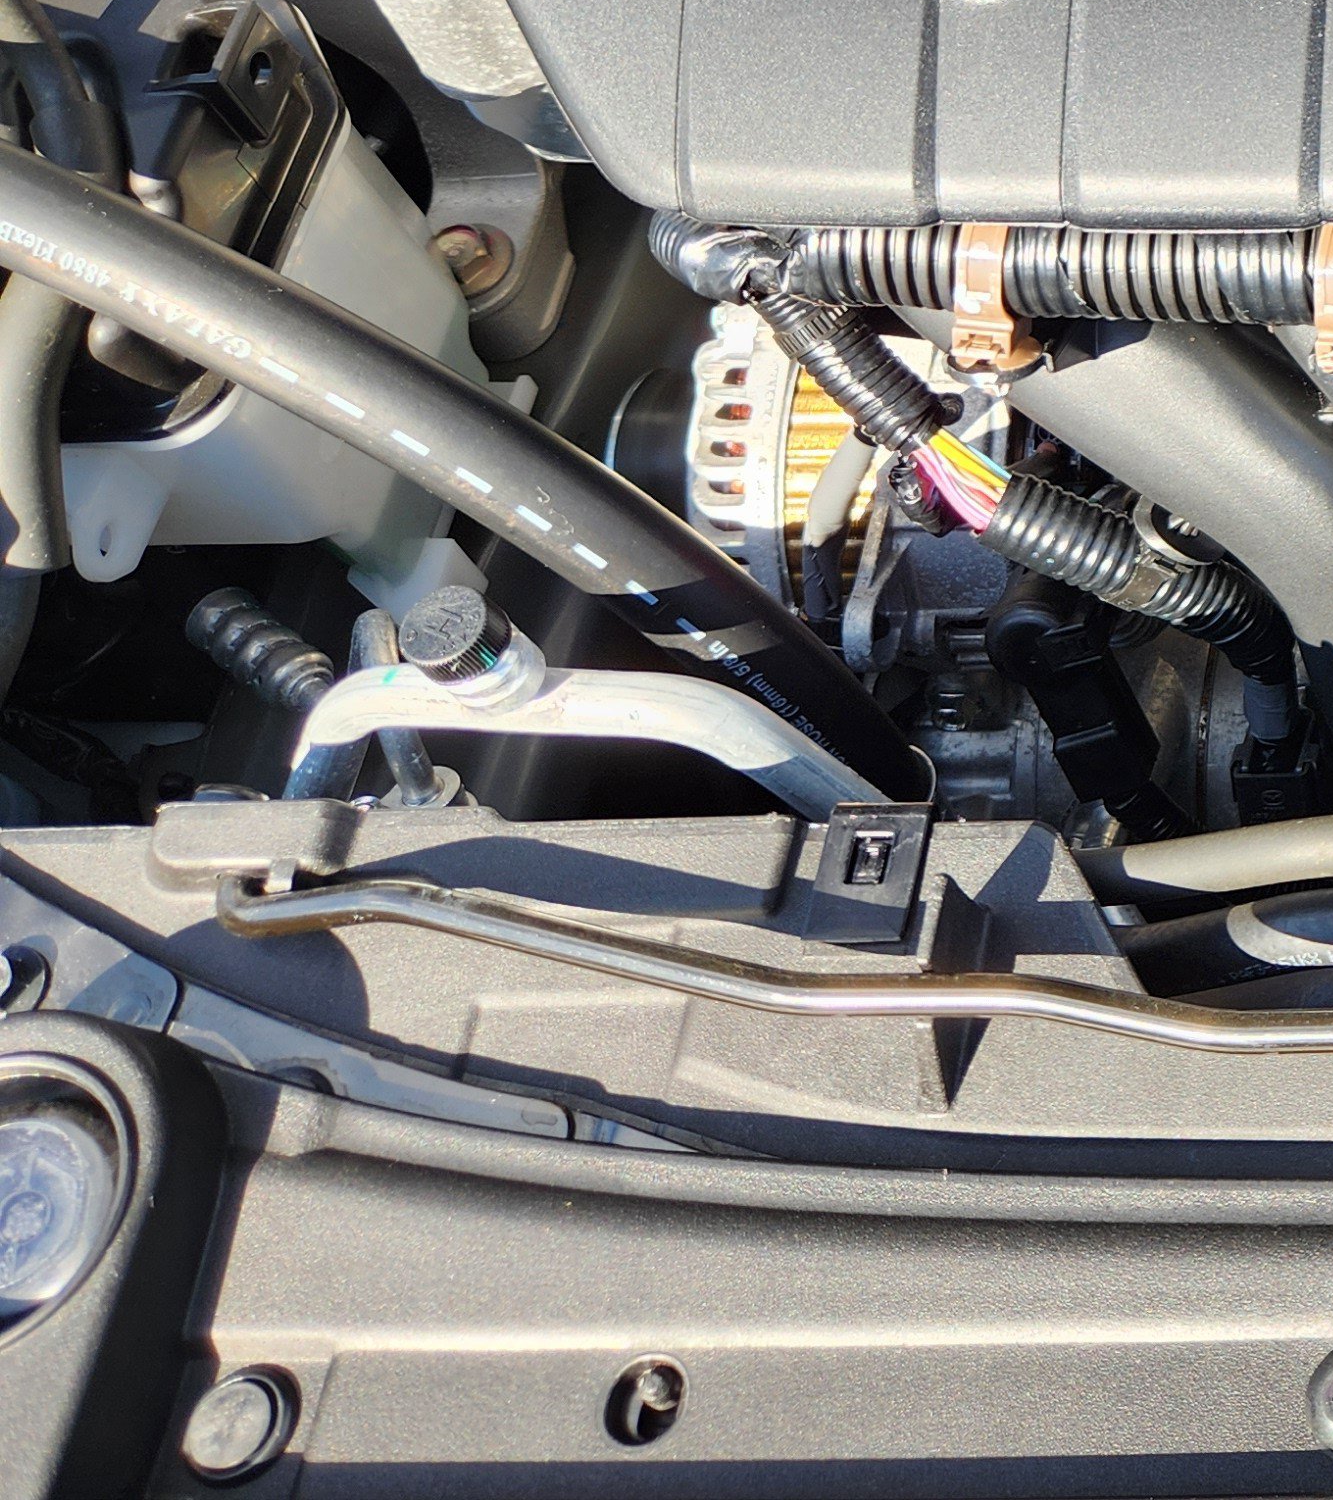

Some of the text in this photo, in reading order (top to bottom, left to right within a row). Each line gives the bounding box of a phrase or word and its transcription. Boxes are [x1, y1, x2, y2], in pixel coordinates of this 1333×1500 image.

[59, 251, 112, 288] 4880
[118, 281, 253, 359] GALAXY
[745, 672, 800, 718] (16mm)
